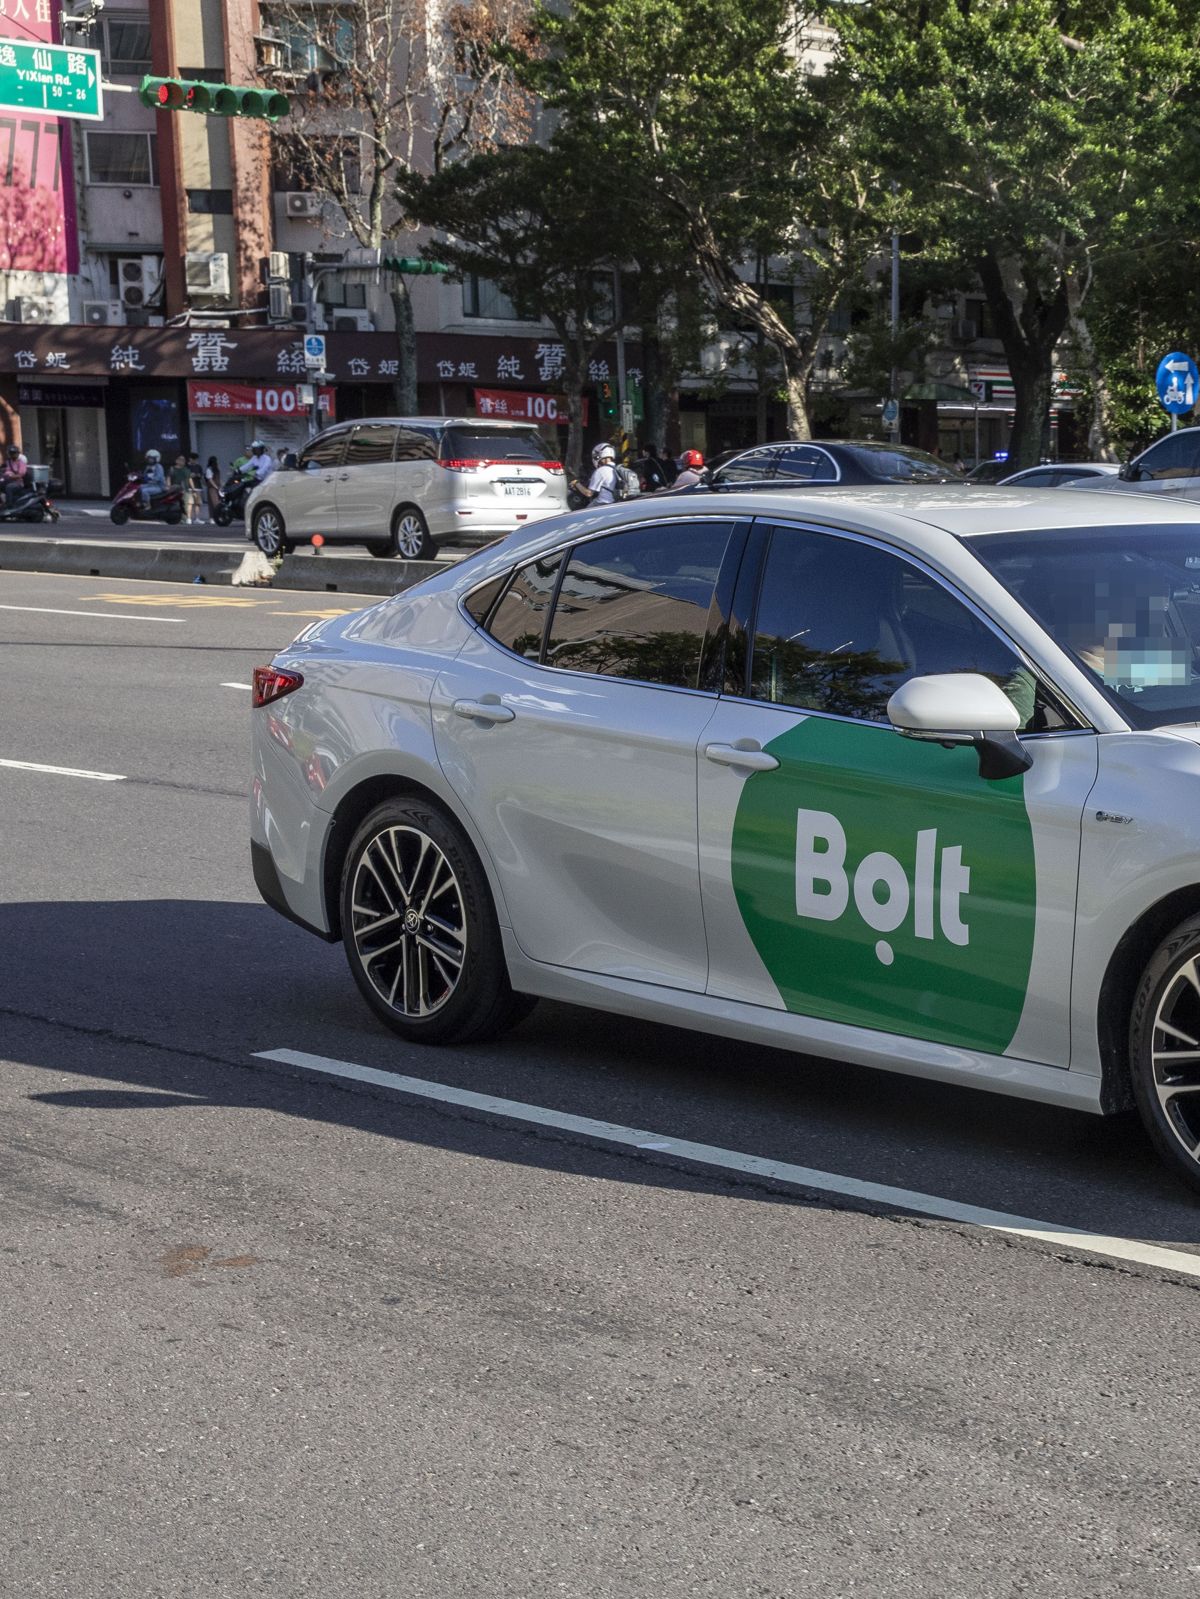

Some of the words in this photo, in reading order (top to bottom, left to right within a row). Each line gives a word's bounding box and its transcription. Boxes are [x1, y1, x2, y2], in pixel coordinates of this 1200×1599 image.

[0, 45, 87, 76] 逸仙路
[55, 73, 72, 86] Rd.
[52, 86, 62, 97] 50
[76, 88, 86, 100] 26
[795, 807, 971, 947] Bolt
